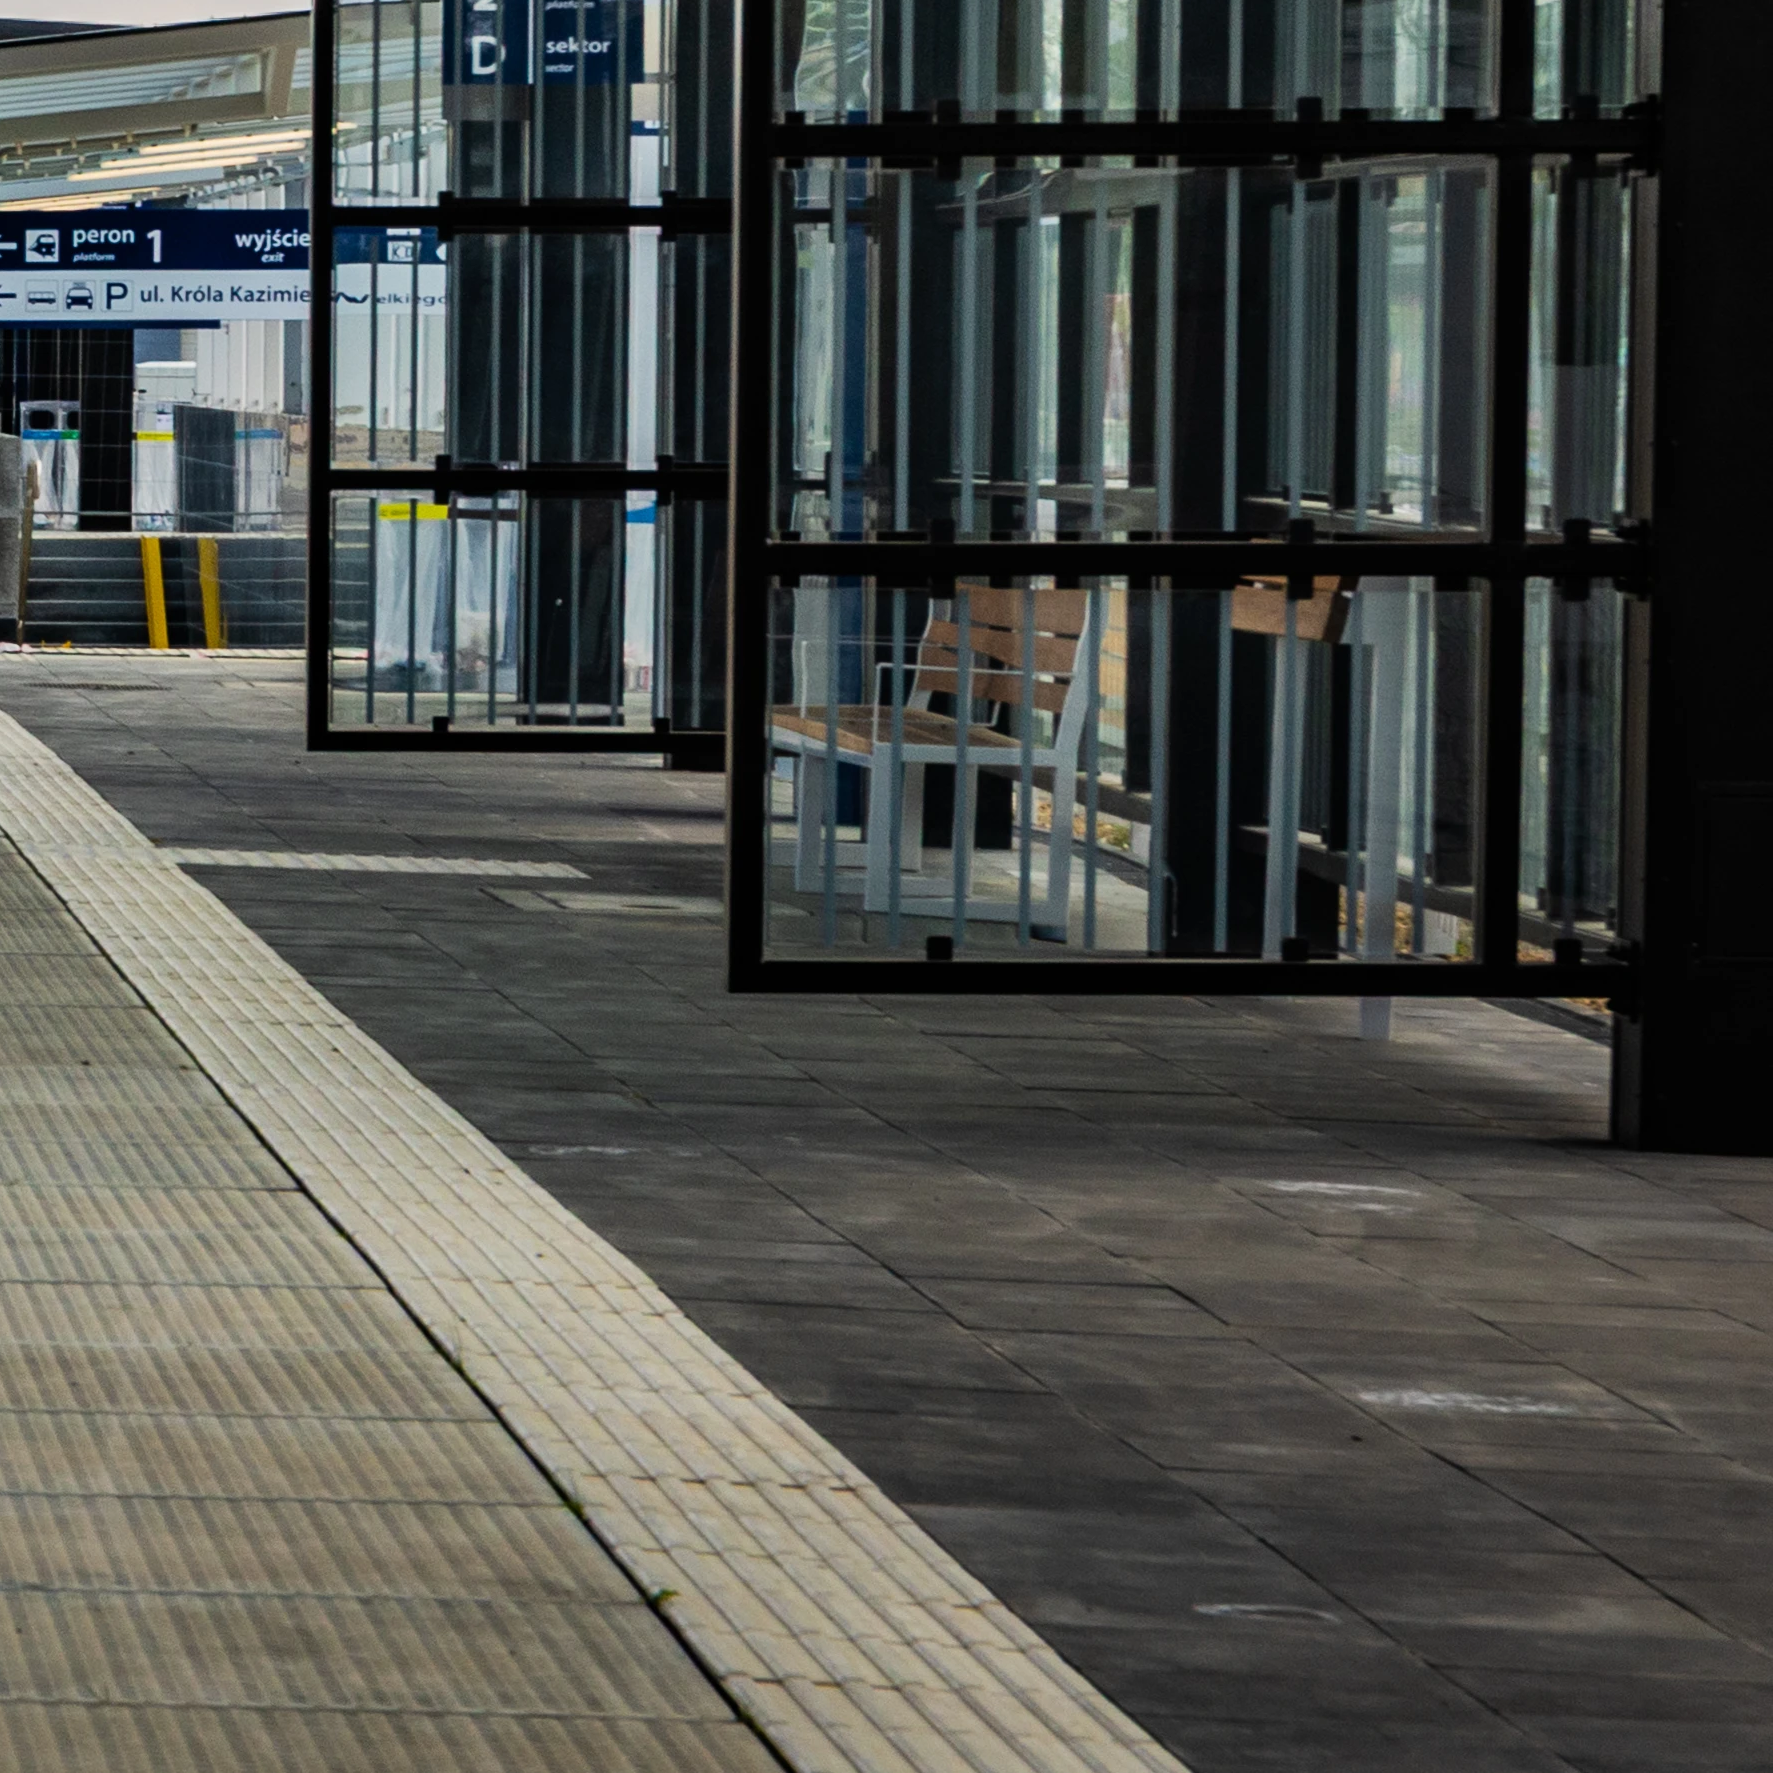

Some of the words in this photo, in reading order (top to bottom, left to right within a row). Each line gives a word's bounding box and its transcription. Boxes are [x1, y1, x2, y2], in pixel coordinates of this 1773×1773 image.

[471, 35, 506, 75] D
[73, 229, 134, 247] peron
[147, 229, 161, 263] 1
[235, 229, 311, 251] wyjście
[73, 252, 115, 263] platform
[261, 252, 285, 263] exit
[140, 285, 164, 303] ul.
[171, 284, 223, 303] Króla
[230, 285, 311, 303] Kazimie
